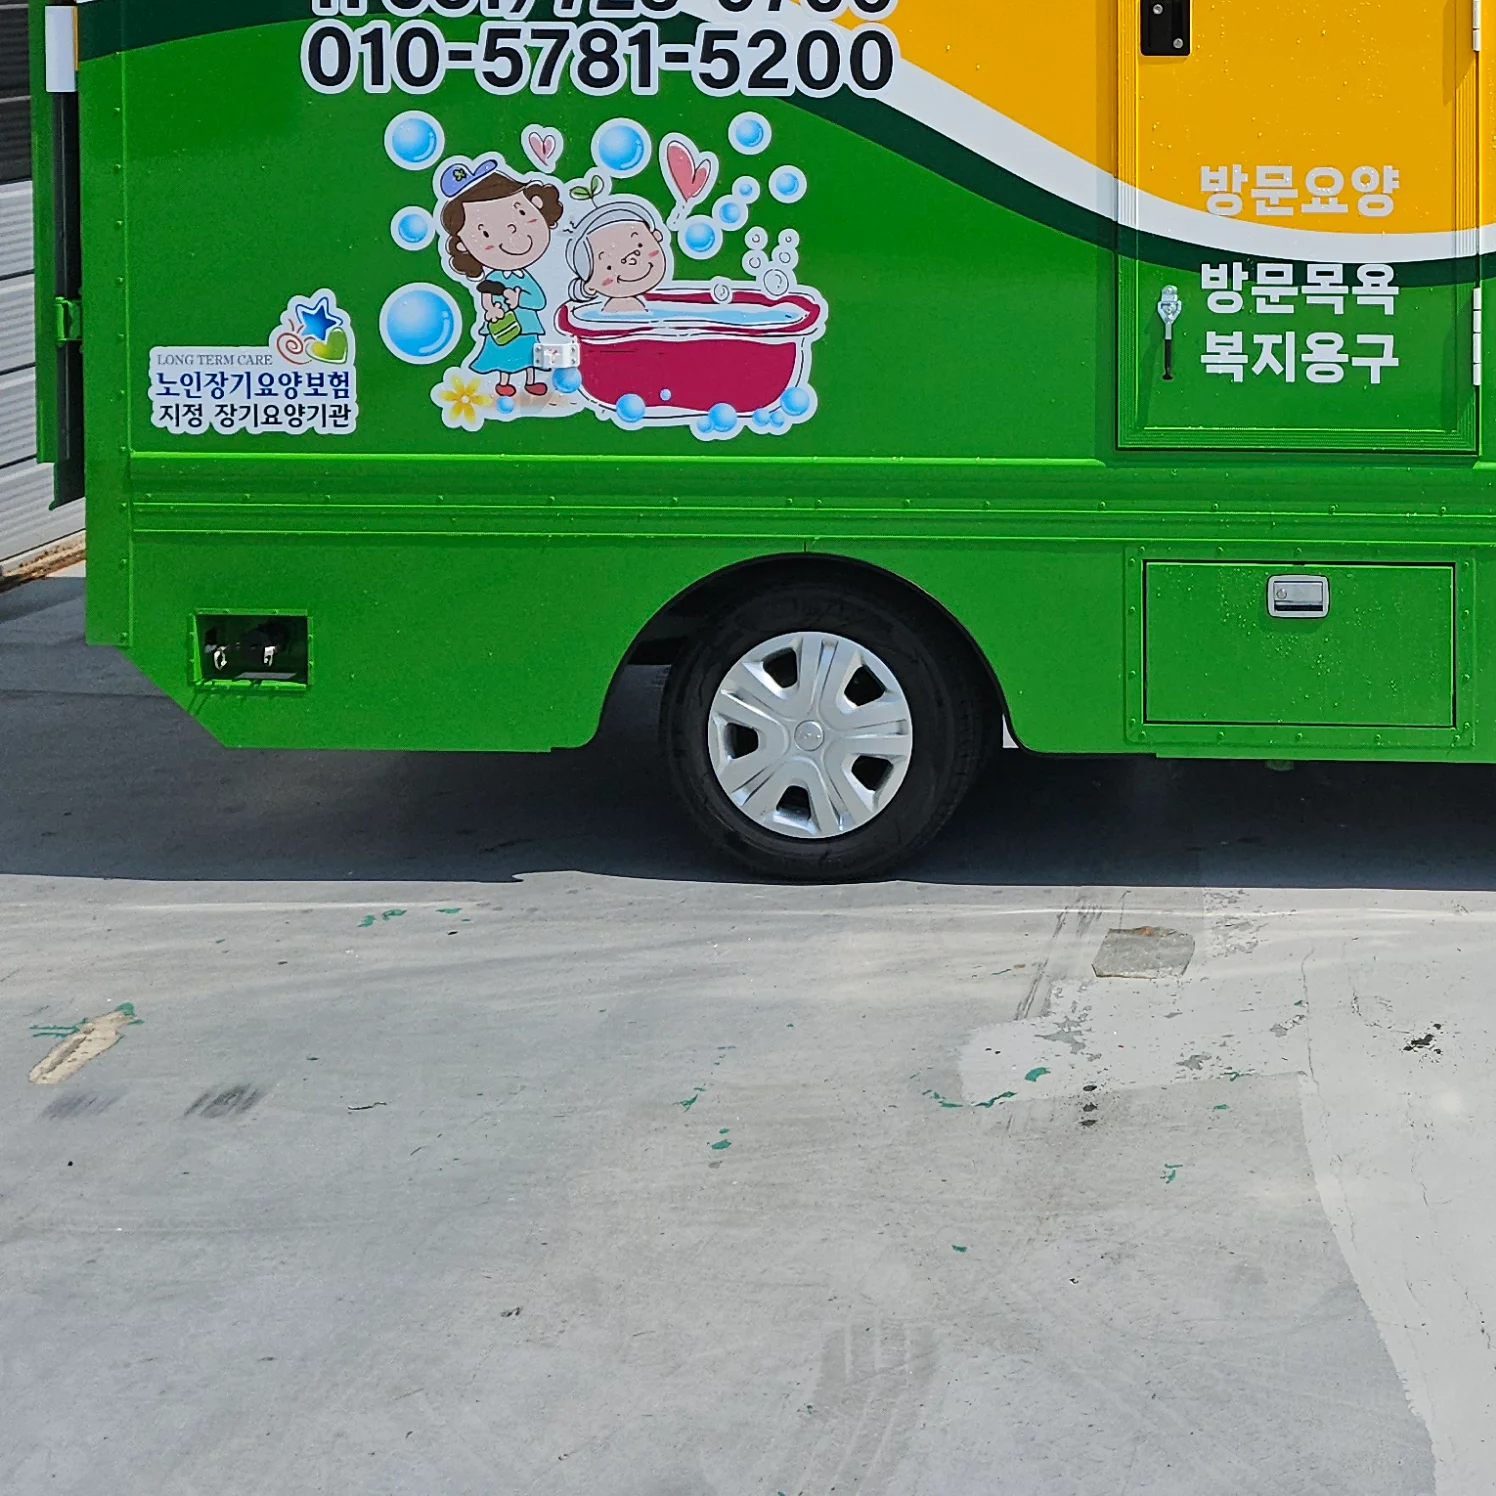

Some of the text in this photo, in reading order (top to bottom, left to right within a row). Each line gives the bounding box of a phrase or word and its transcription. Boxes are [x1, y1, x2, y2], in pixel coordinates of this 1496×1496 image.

[307, 26, 895, 92] 010-5781-5200
[1200, 164, 1400, 218] 방문요양
[1200, 261, 1400, 316] 방문목욕
[157, 354, 273, 366] LONG TERM CARE
[1200, 331, 1400, 385] 복지용구
[156, 371, 350, 400] 노인장기요양보험
[159, 403, 352, 428] 지정 장기요양기관
